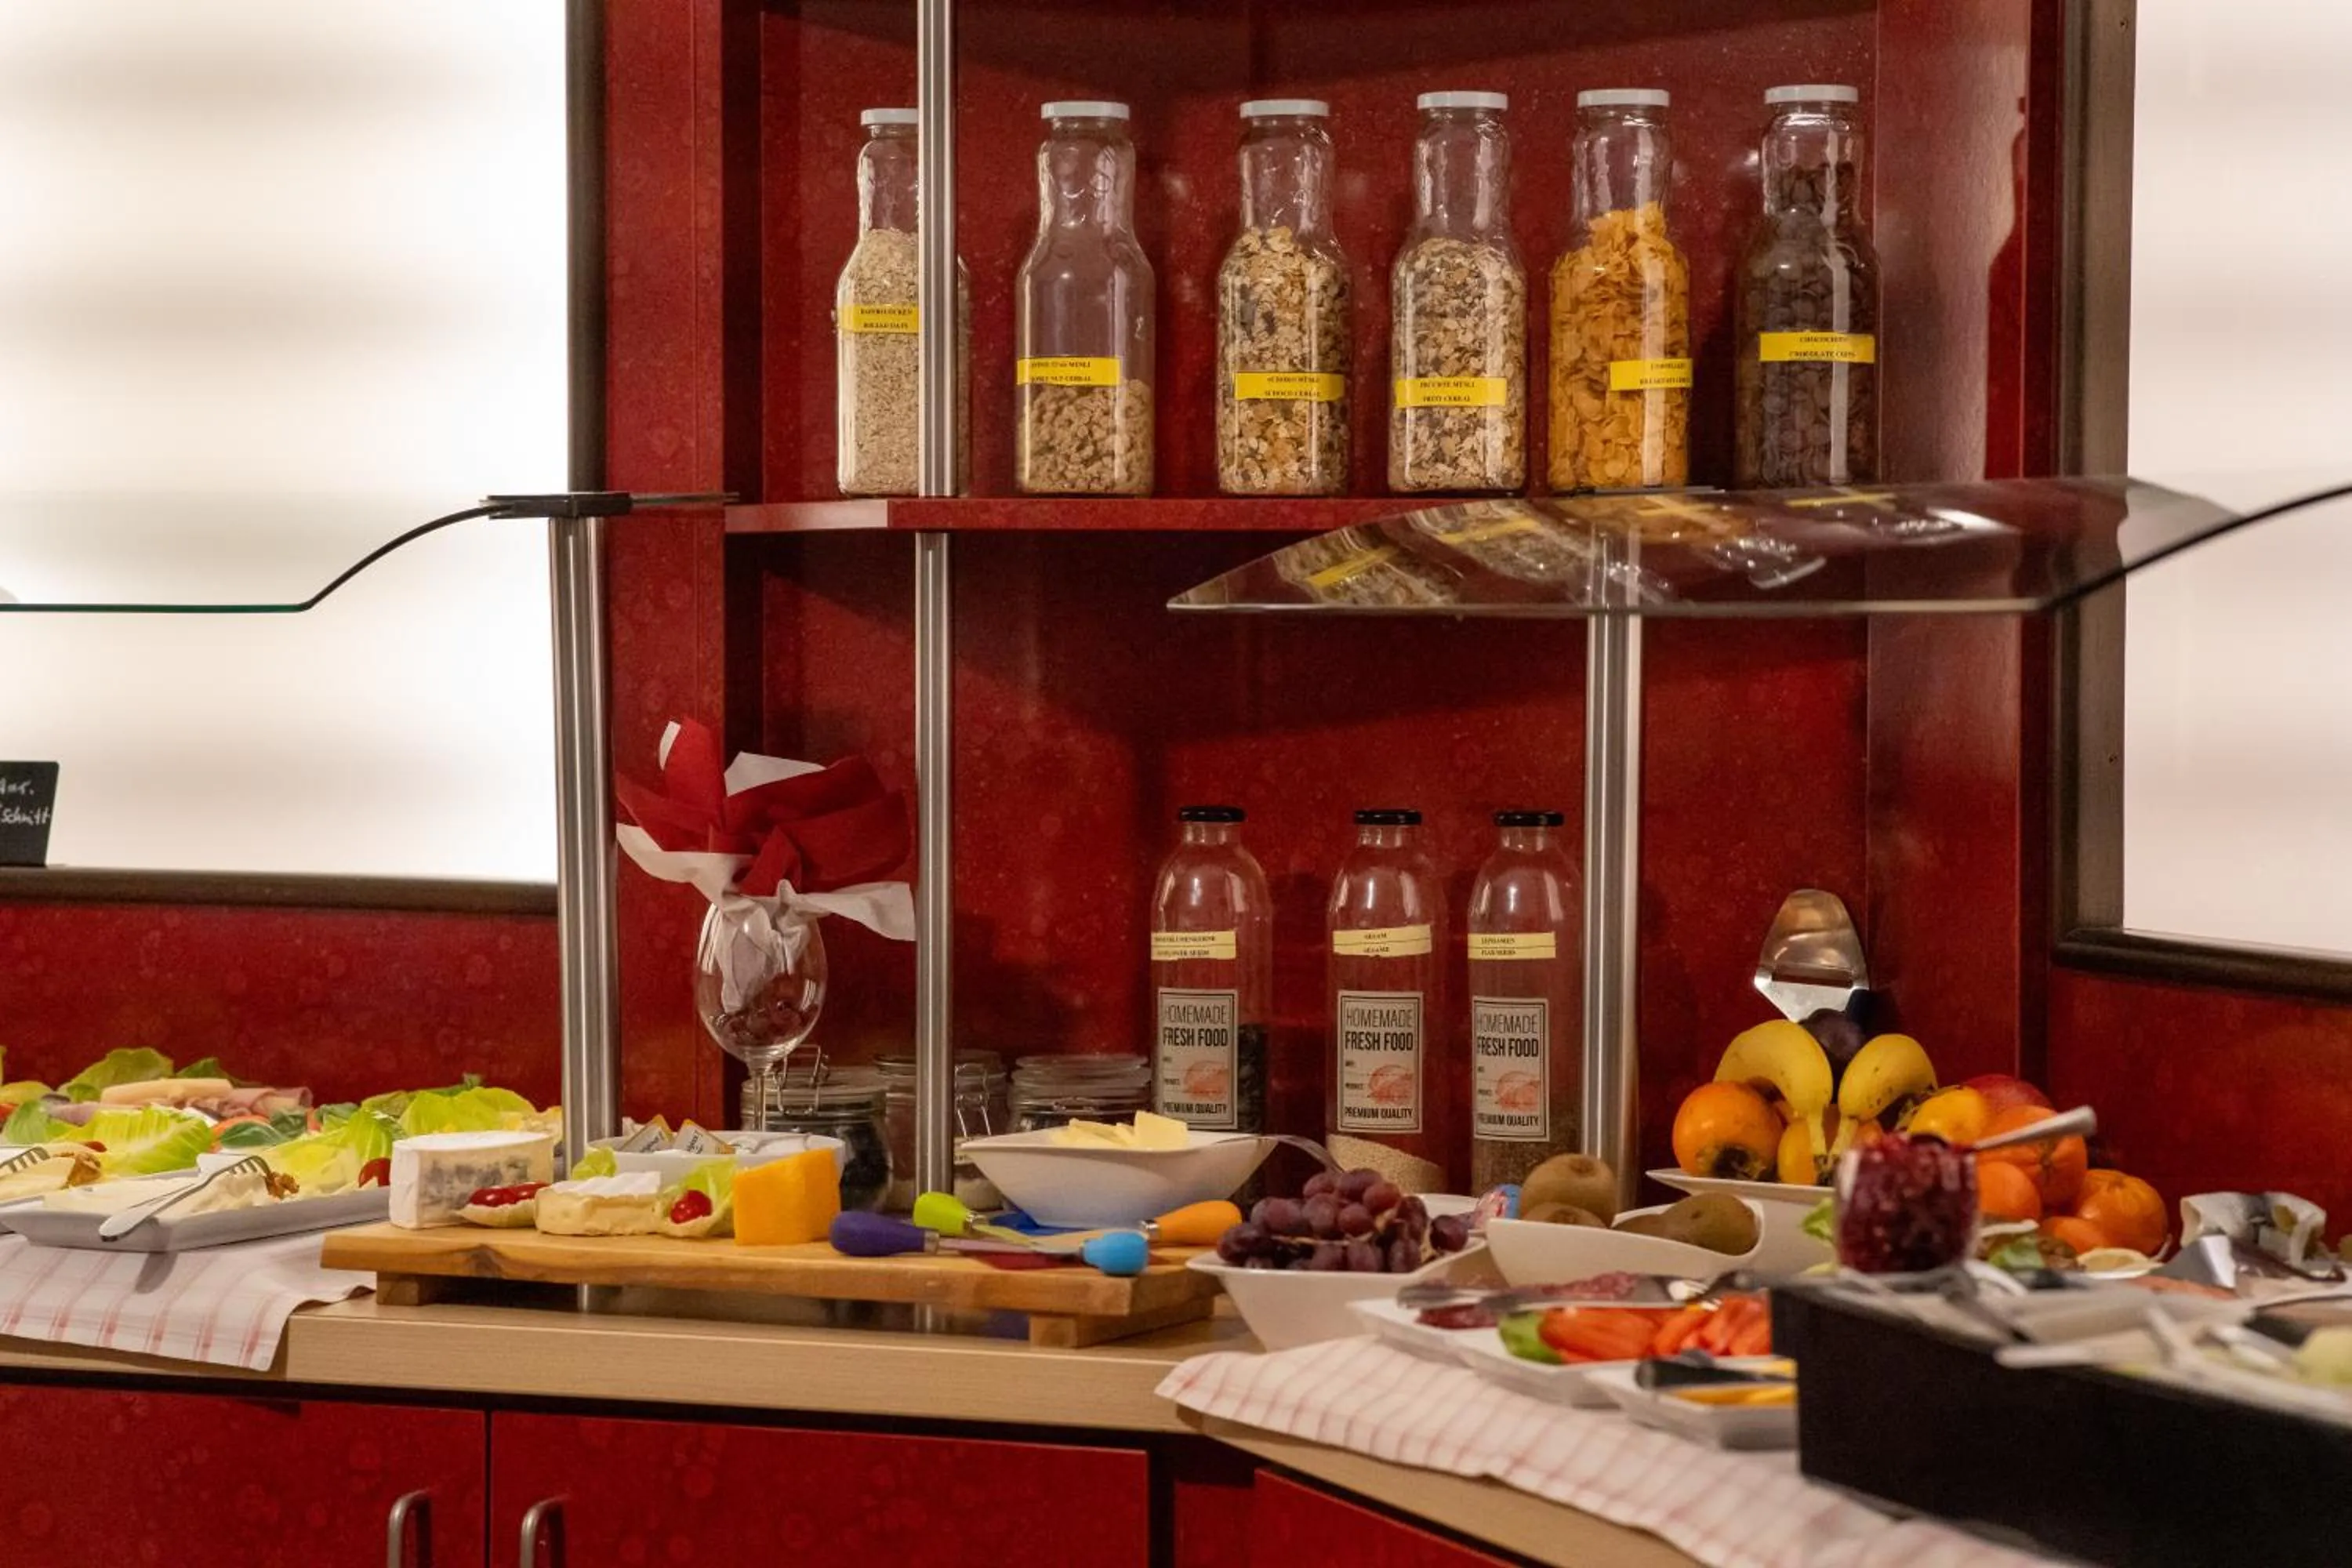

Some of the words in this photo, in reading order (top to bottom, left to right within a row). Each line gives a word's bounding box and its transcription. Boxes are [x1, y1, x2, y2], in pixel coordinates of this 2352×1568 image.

[1164, 1004, 1226, 1025] HOMEMADE
[1345, 1007, 1414, 1028] HOMEMADE
[1476, 1013, 1537, 1034] HOMEMADE
[1163, 1026, 1195, 1047] FRESH
[1197, 1028, 1229, 1047] FOOD
[1345, 1030, 1381, 1051] FRESH
[1384, 1032, 1414, 1051] FOOD
[1476, 1036, 1506, 1057] FRESH
[1508, 1038, 1539, 1058] FOOD
[1163, 1102, 1194, 1114] PREMIUM
[1195, 1103, 1227, 1114] QUALITY
[1345, 1106, 1379, 1119] PREMIUM
[1381, 1108, 1413, 1119] QUALITY
[1476, 1113, 1504, 1125] PREMIUM
[1506, 1115, 1539, 1127] QUALITY
